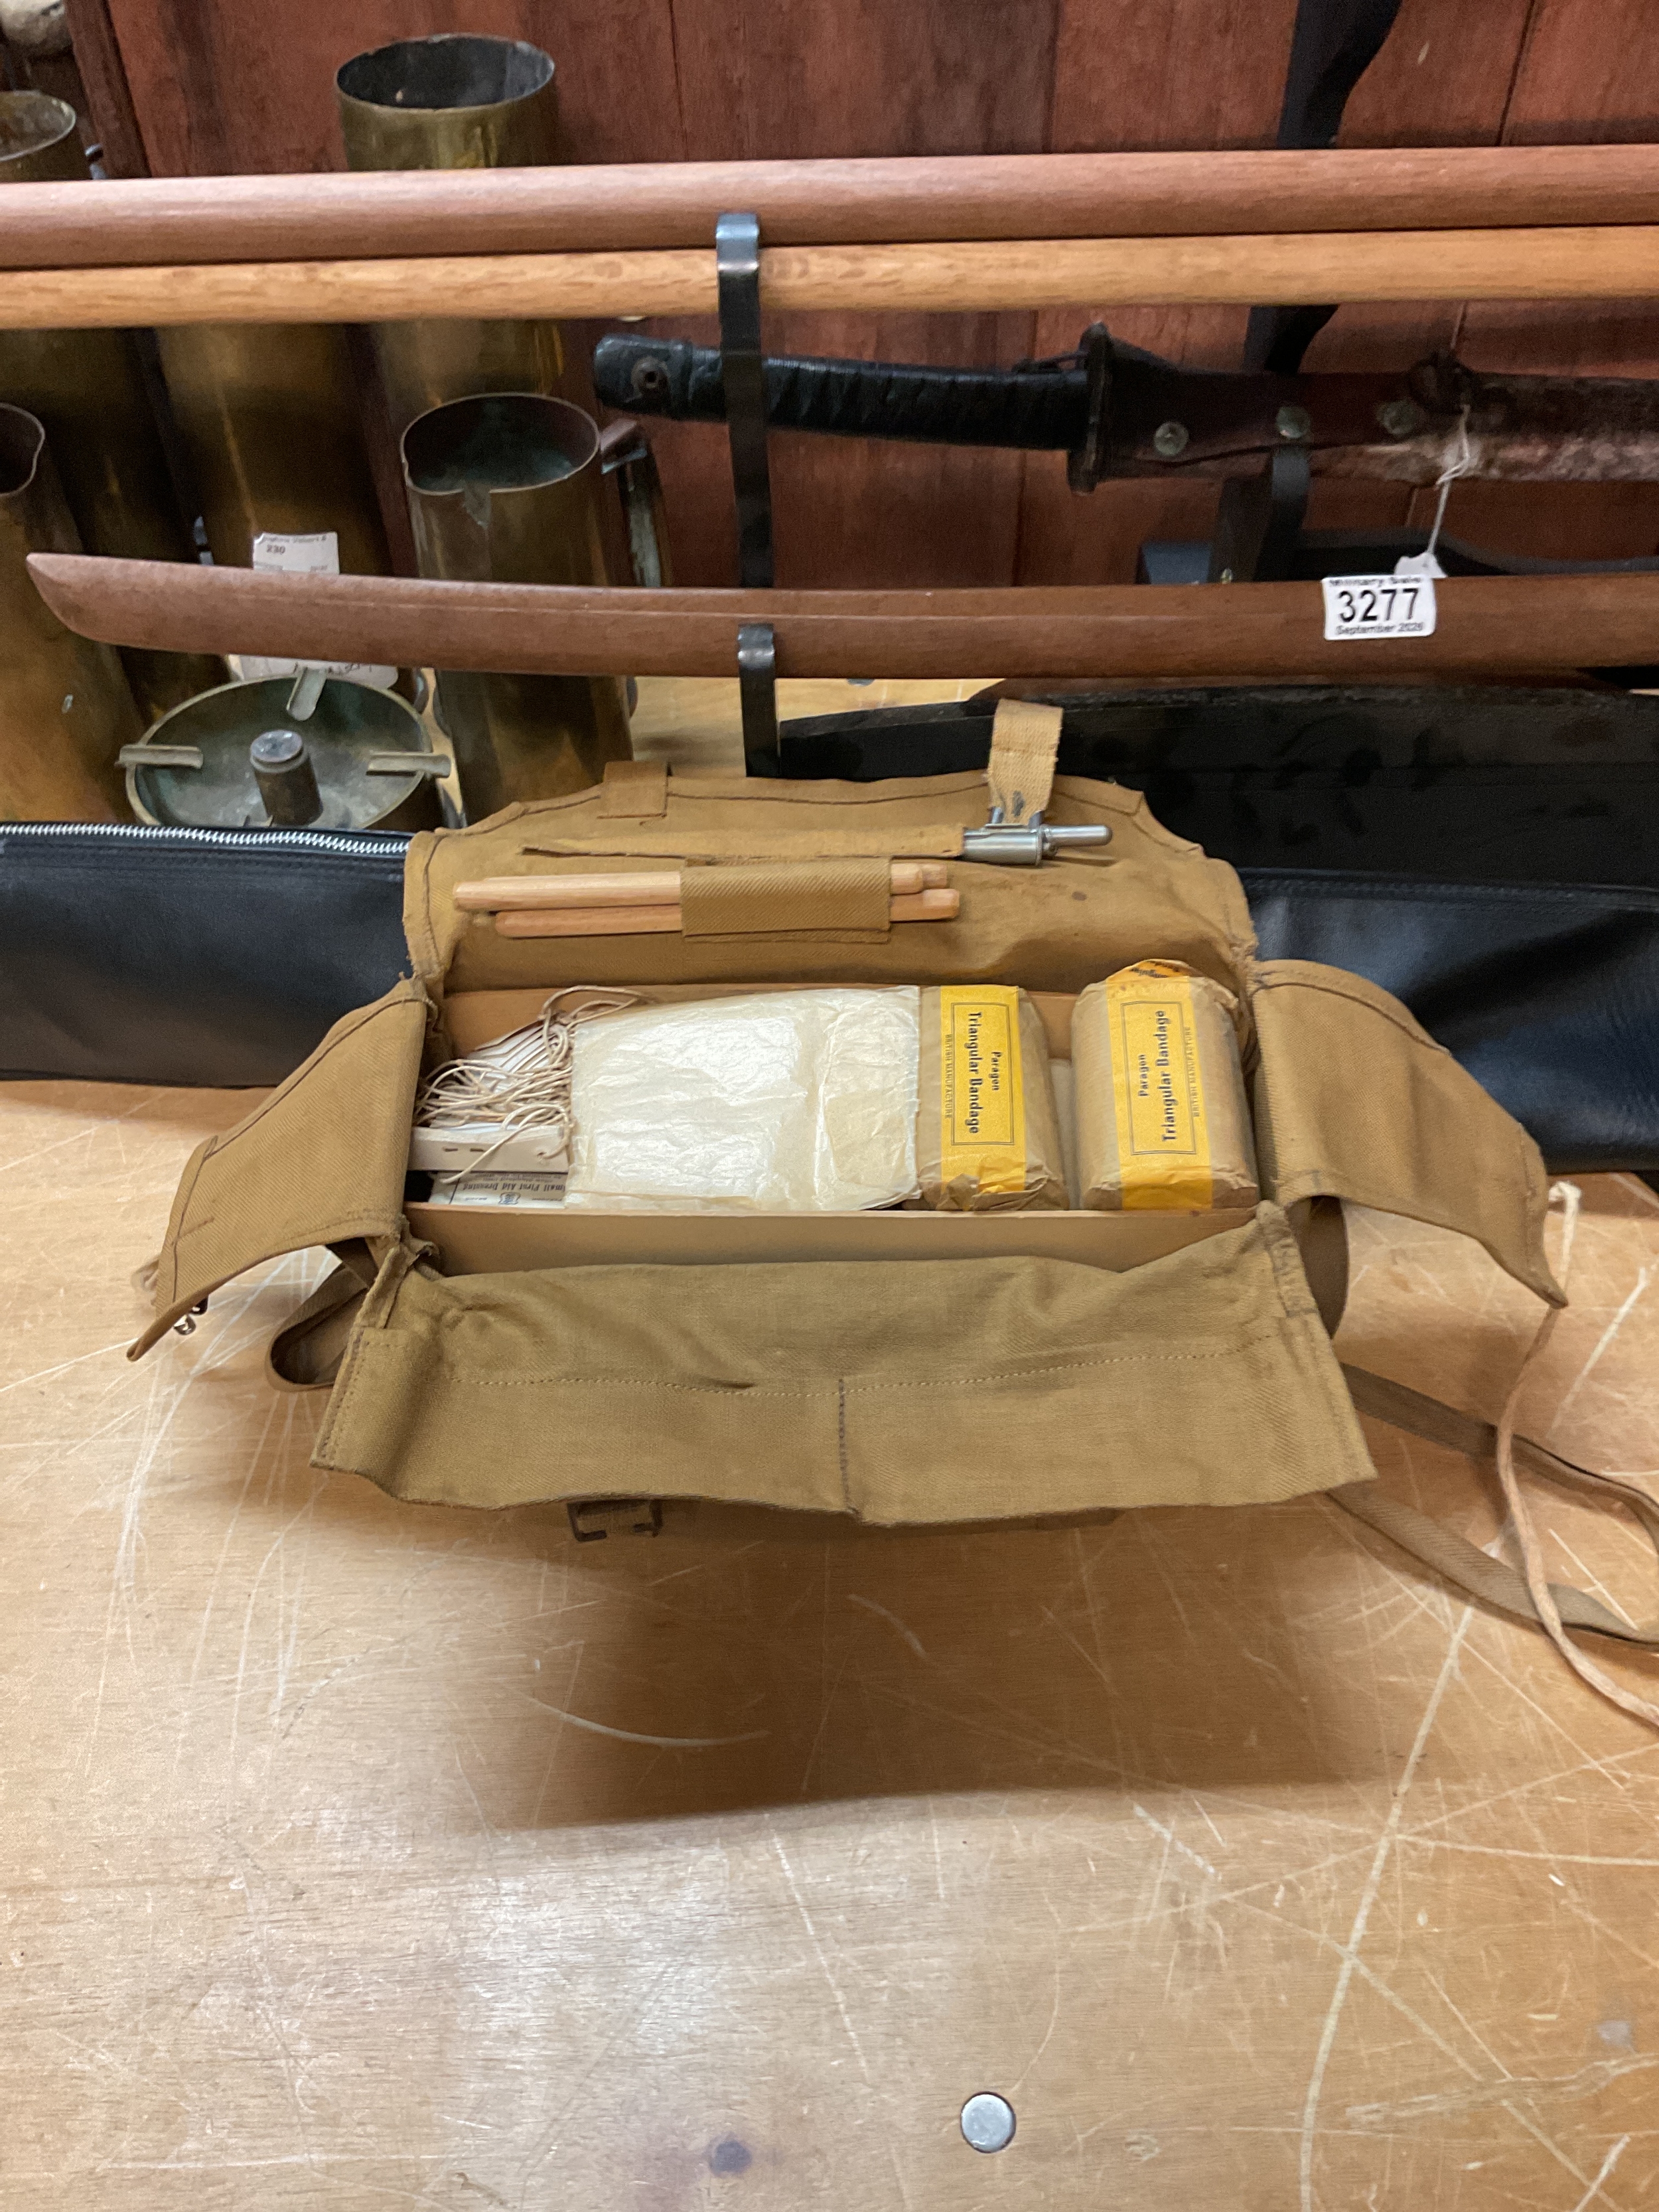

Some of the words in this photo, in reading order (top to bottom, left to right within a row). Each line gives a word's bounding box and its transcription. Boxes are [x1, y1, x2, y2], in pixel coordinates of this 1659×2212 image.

[1338, 588, 1419, 623] 3277
[1336, 625, 1396, 634] September
[944, 1034, 953, 1063] BRITISH
[964, 1012, 983, 1075] Triangular
[1152, 1010, 1172, 1067] Bandage
[1184, 1026, 1197, 1084] MANUFACTURE
[988, 1051, 1003, 1091] Paragon
[1137, 1054, 1150, 1096] Paragon
[944, 1064, 954, 1119] MANUFACTURE
[965, 1078, 984, 1134] Bandage
[1157, 1070, 1179, 1142] Triangular
[1189, 1085, 1200, 1118] BRITISH
[463, 1181, 498, 1191] Dressing
[502, 1182, 516, 1191] Aid
[519, 1182, 541, 1192] First
